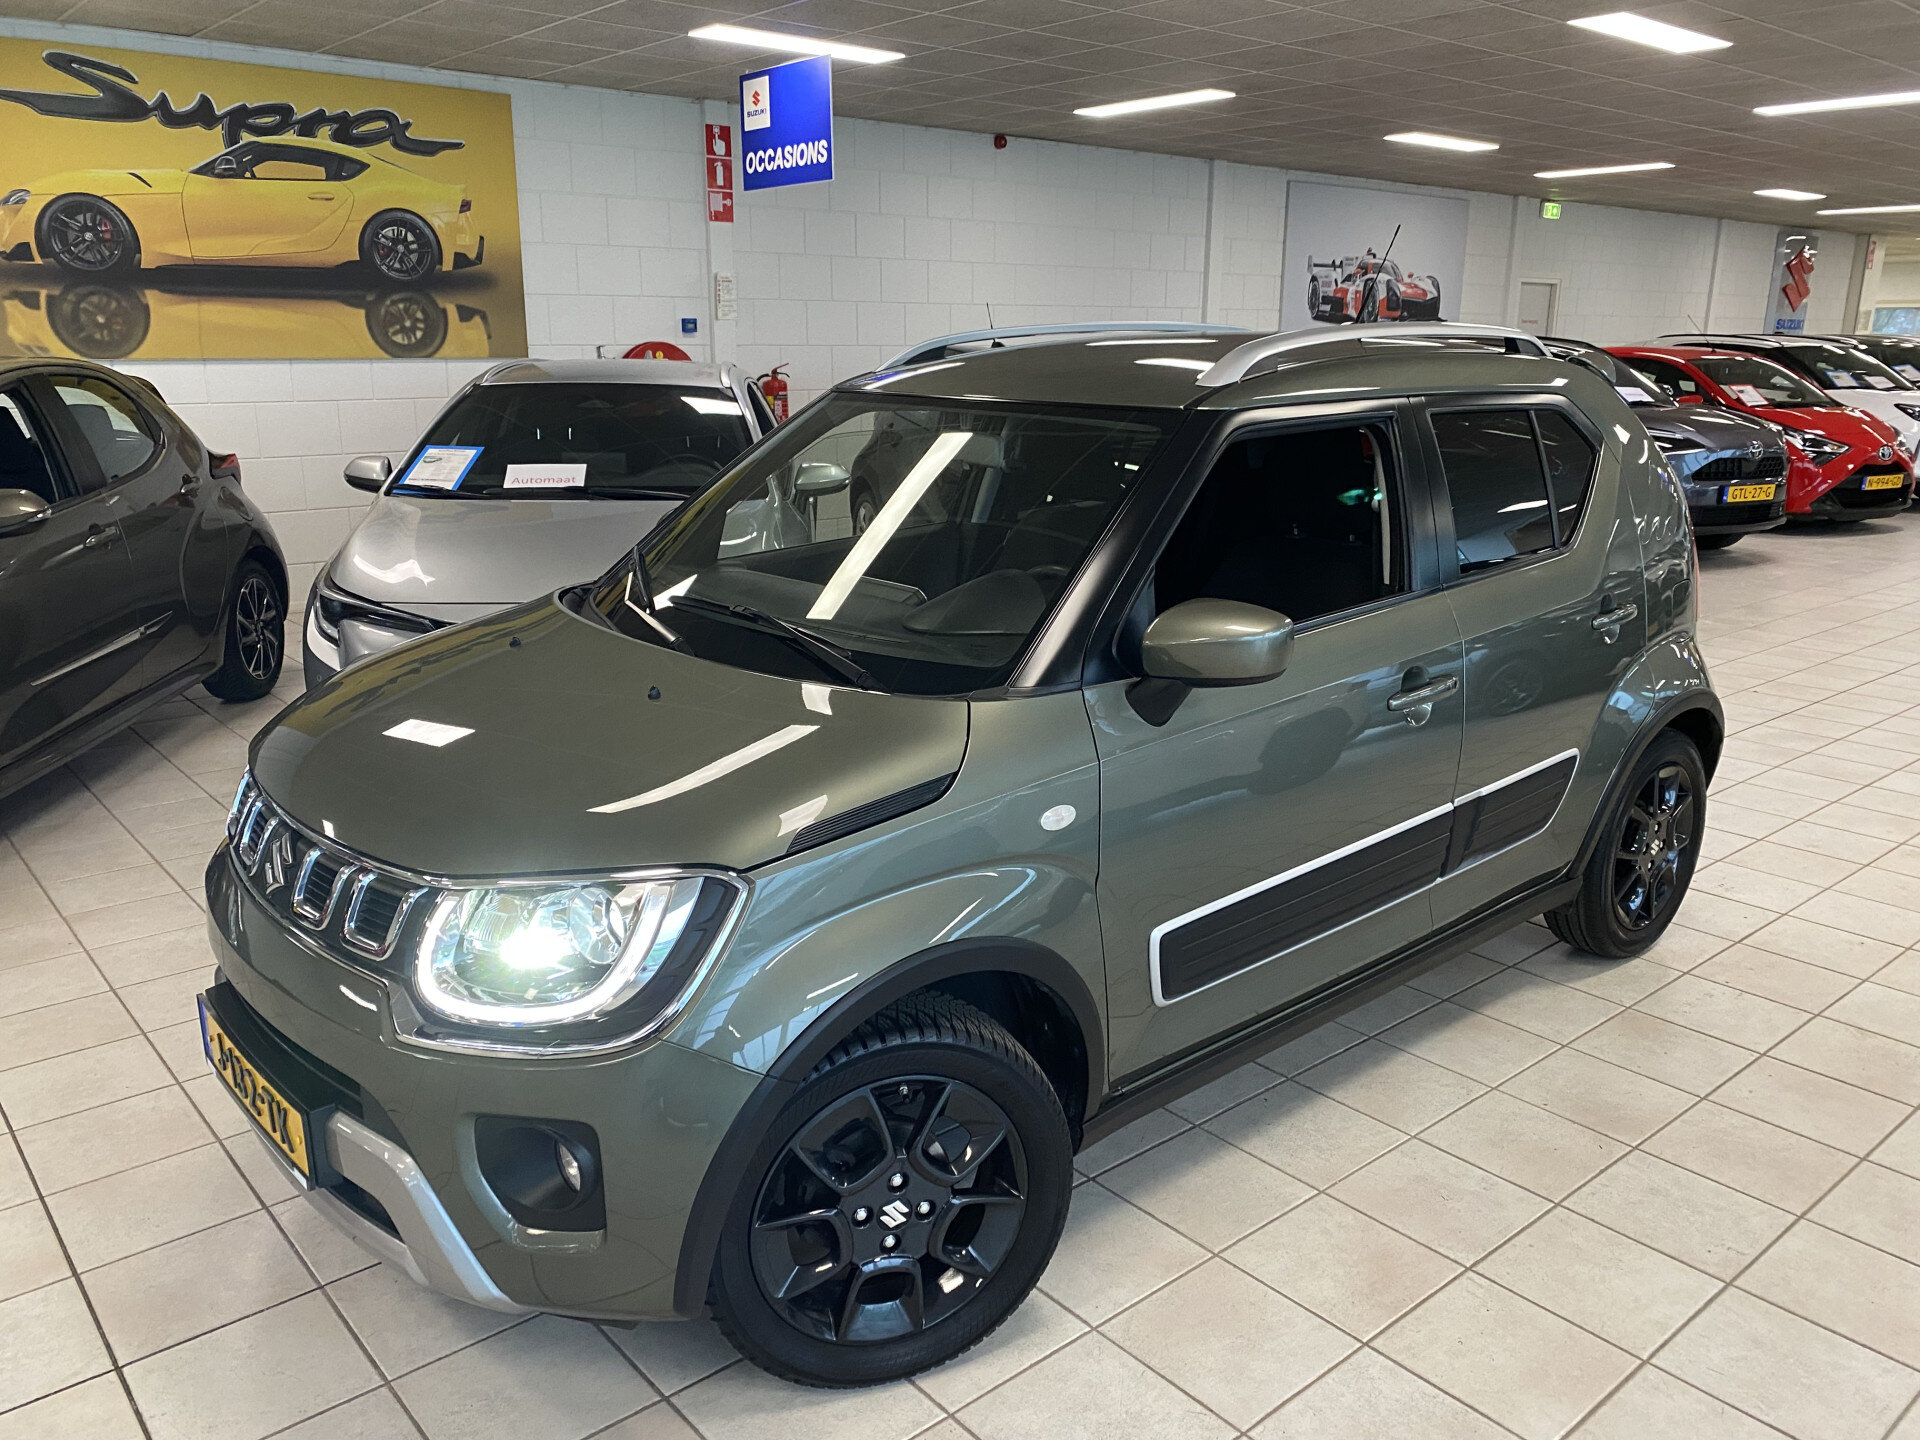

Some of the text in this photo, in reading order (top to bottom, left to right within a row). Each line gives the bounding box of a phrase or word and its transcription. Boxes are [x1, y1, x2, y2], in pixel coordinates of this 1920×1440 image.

[0, 50, 466, 157] Supra
[746, 108, 767, 118] SUZUKI
[745, 139, 828, 175] OCCASIONS
[511, 476, 576, 485] Automaat
[1732, 486, 1771, 500] GTL-27-G
